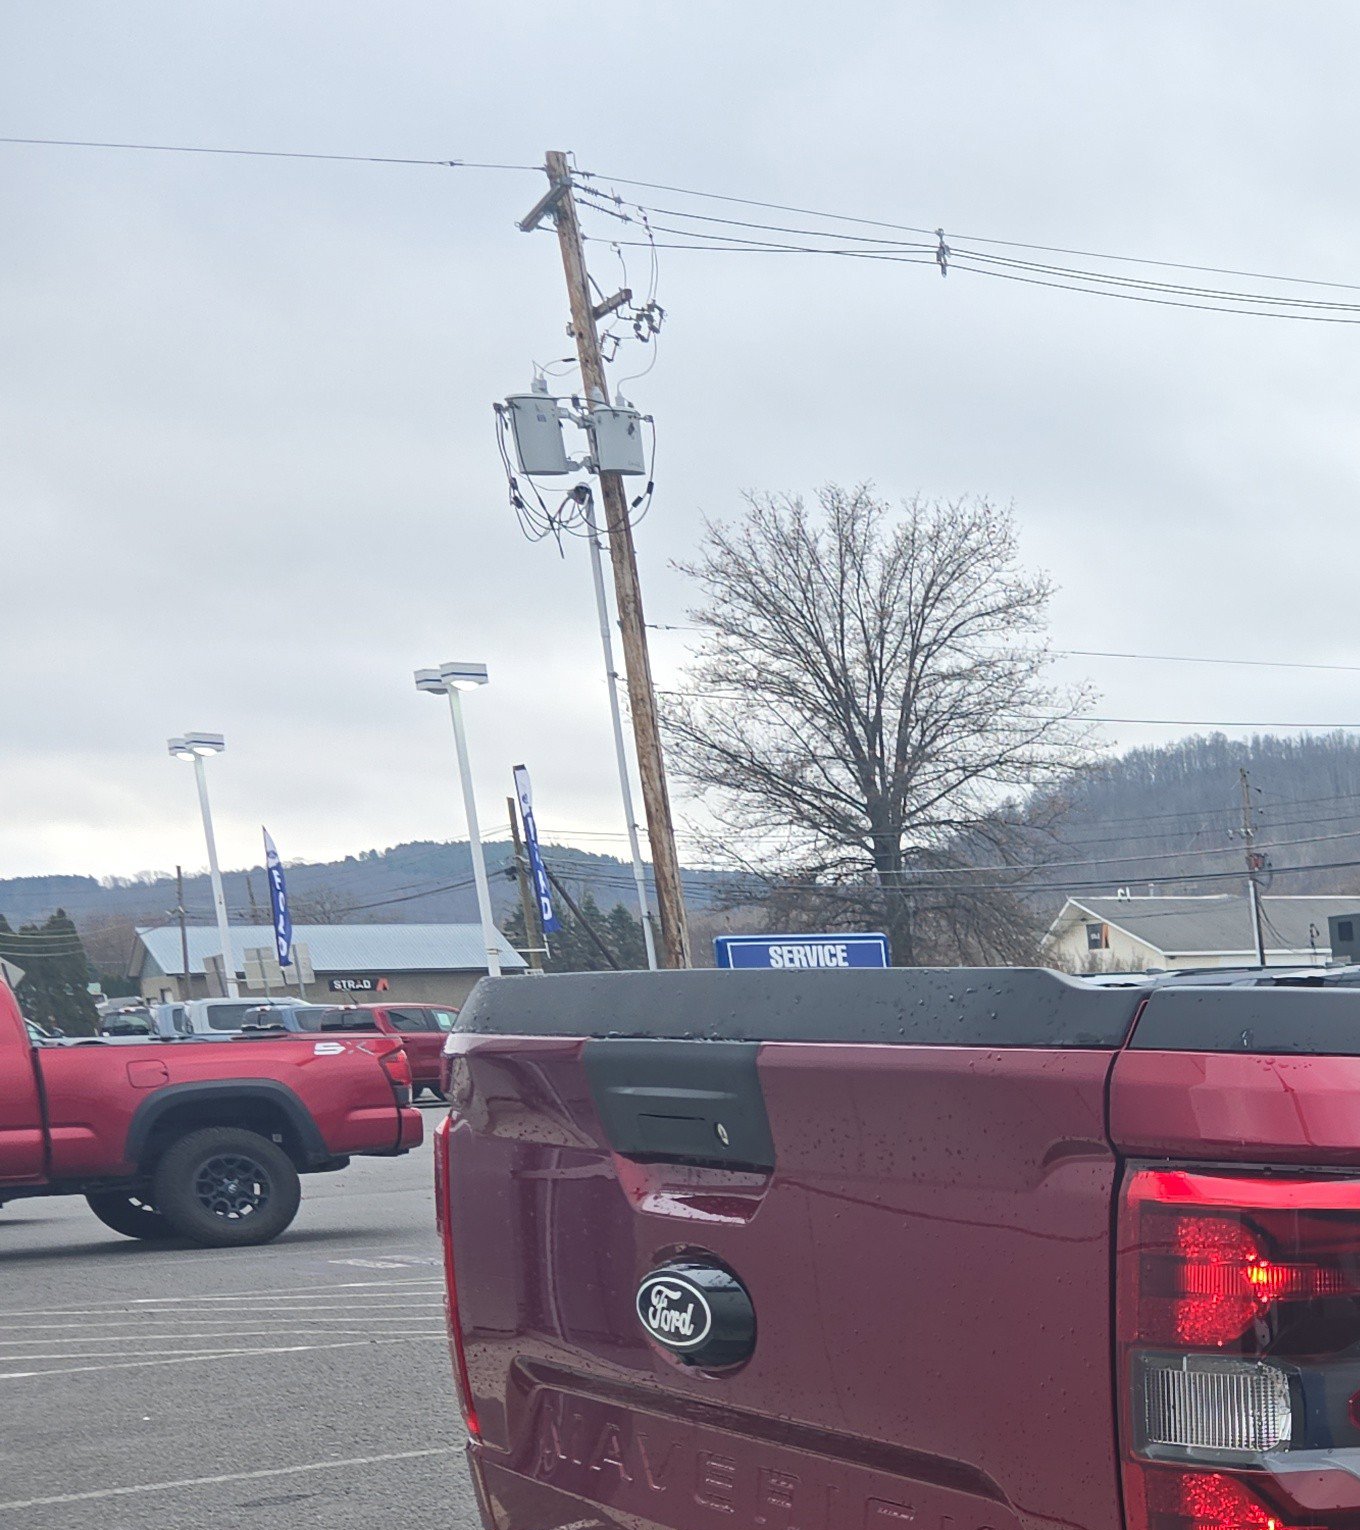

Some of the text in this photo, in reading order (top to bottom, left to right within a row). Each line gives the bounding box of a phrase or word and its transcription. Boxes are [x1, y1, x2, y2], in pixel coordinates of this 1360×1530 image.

[768, 943, 850, 968] SERVICE
[332, 979, 372, 990] STRAD
[648, 1284, 695, 1336] Ford
